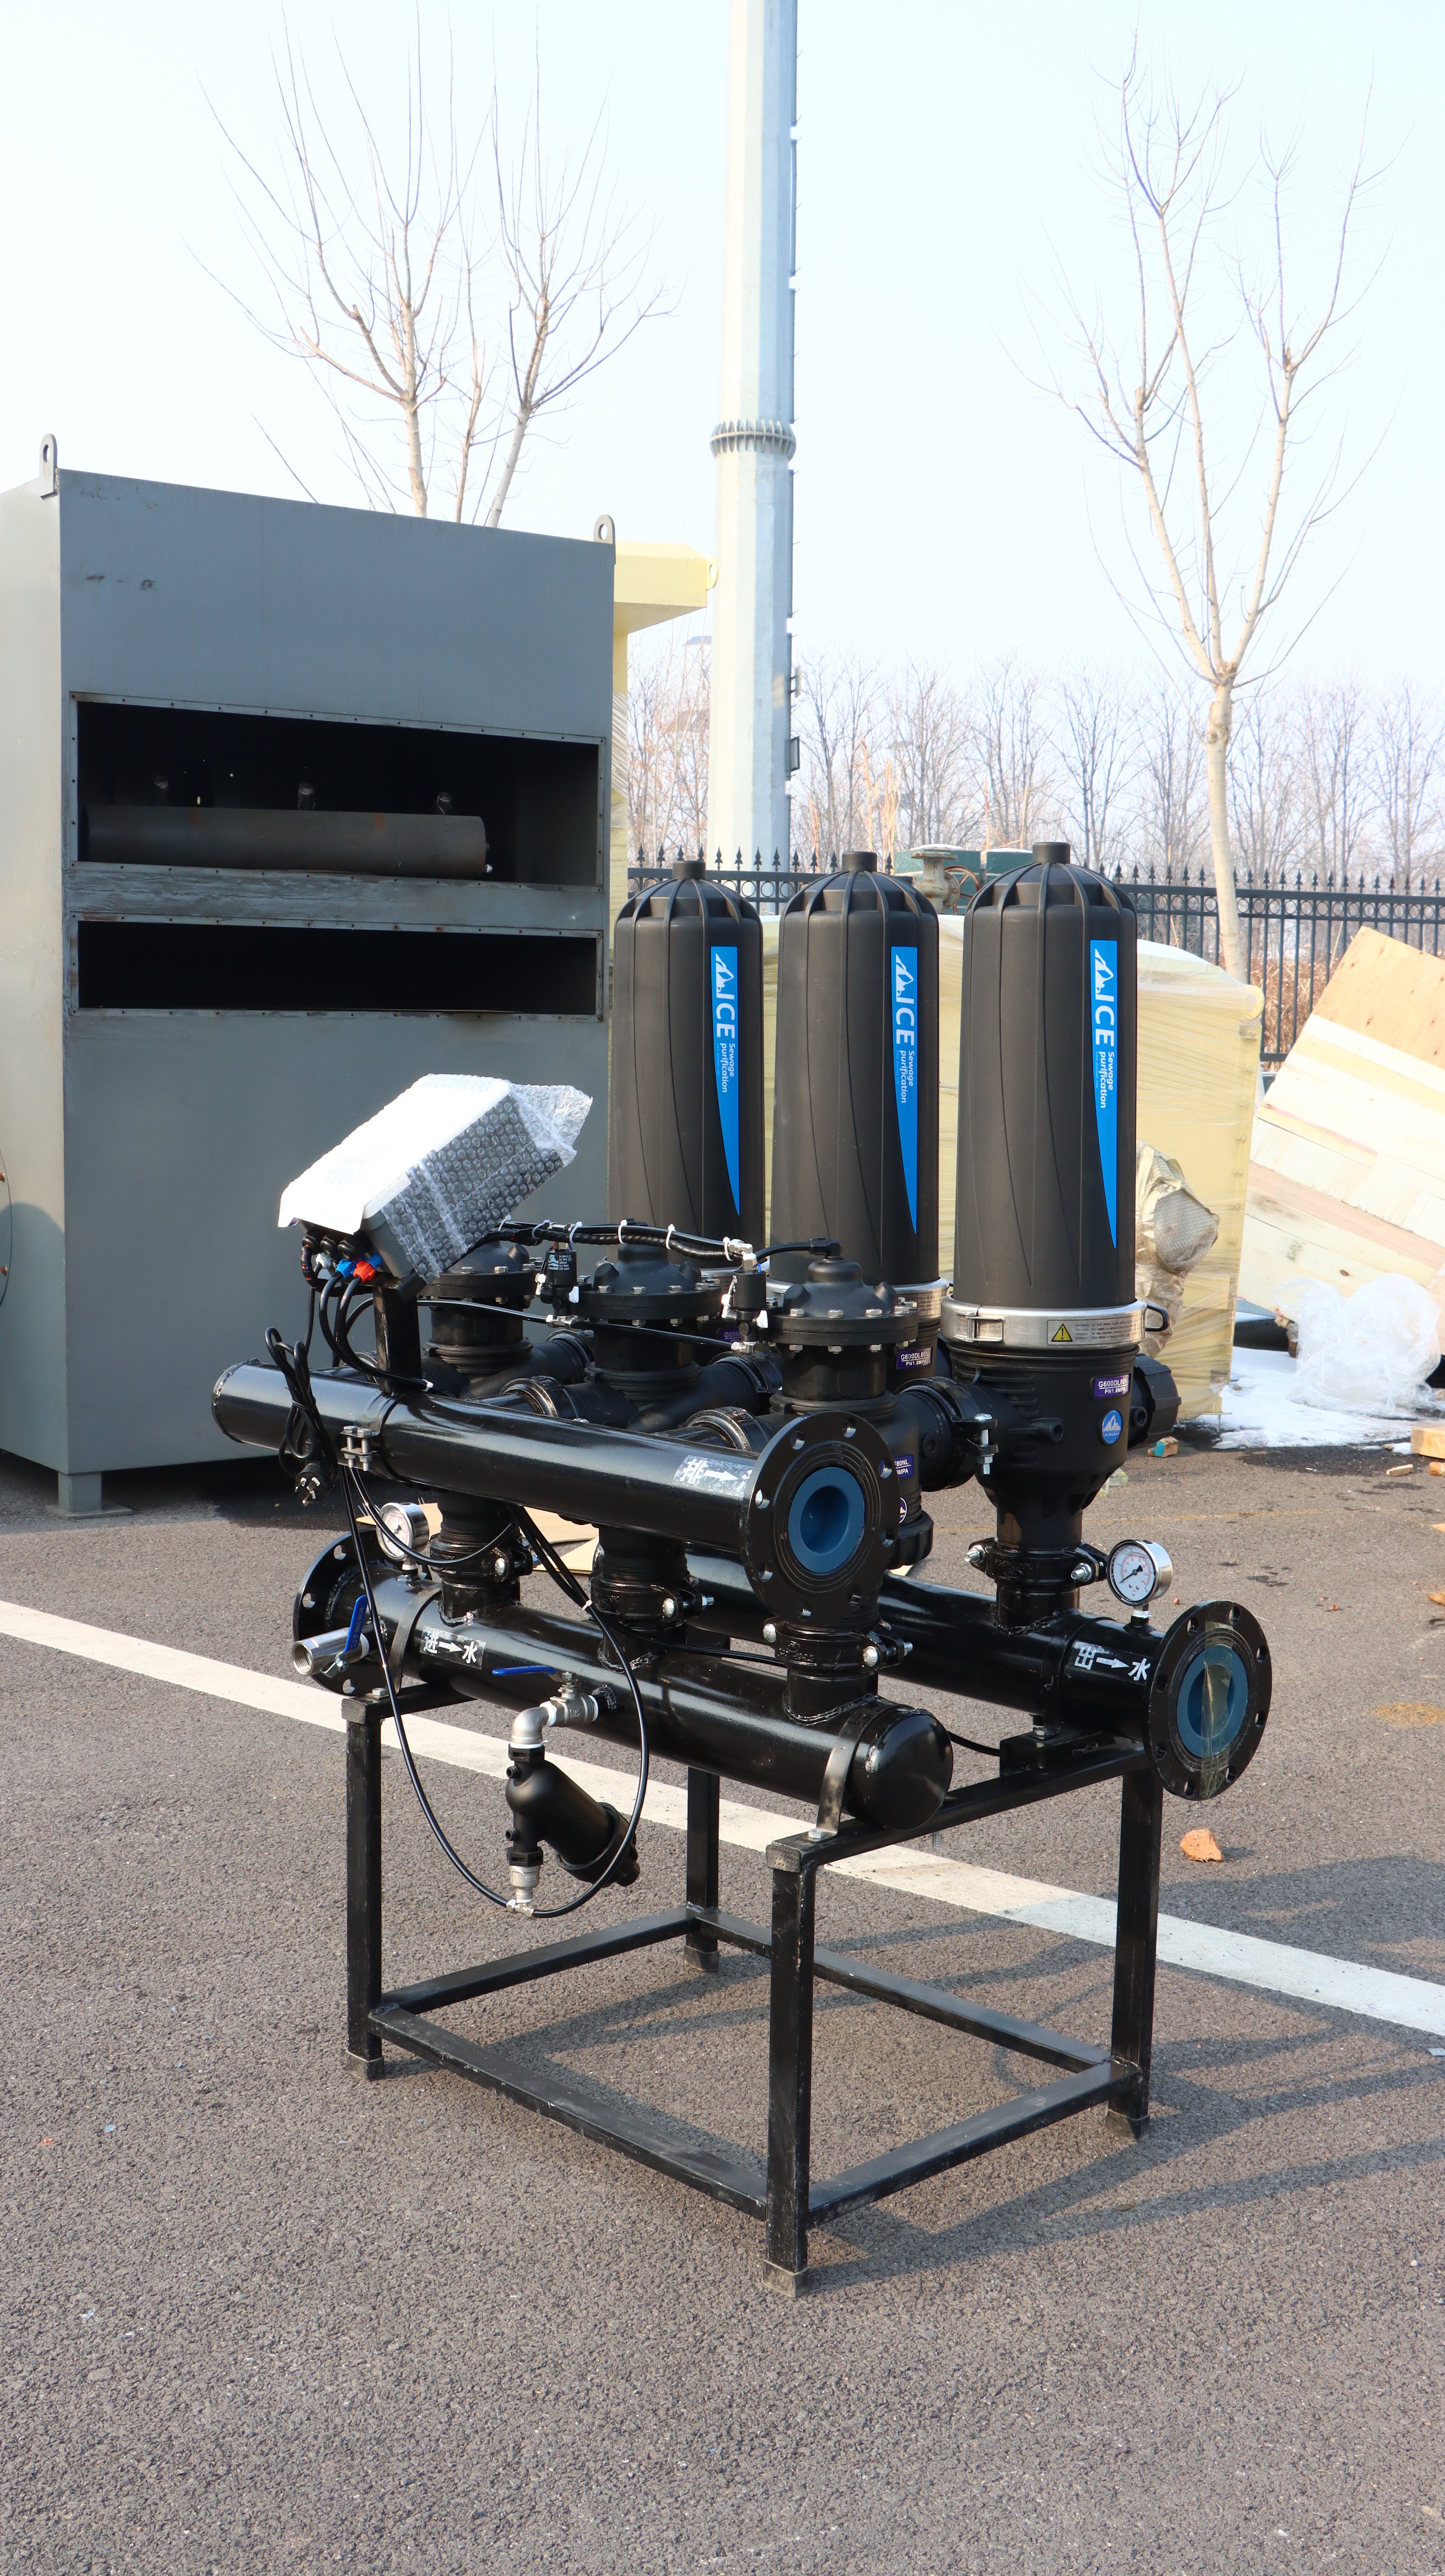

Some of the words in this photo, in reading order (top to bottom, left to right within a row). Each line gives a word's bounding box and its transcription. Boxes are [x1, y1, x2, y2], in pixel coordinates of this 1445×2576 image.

[716, 993, 735, 1039] ICE
[896, 997, 914, 1046] ICE
[1095, 994, 1114, 1047] ICE
[720, 1043, 729, 1093] purification
[899, 1050, 908, 1103] purification
[1099, 1051, 1107, 1108] purification
[1106, 1051, 1114, 1090] Sewage
[901, 1352, 931, 1360] G600DL80NL
